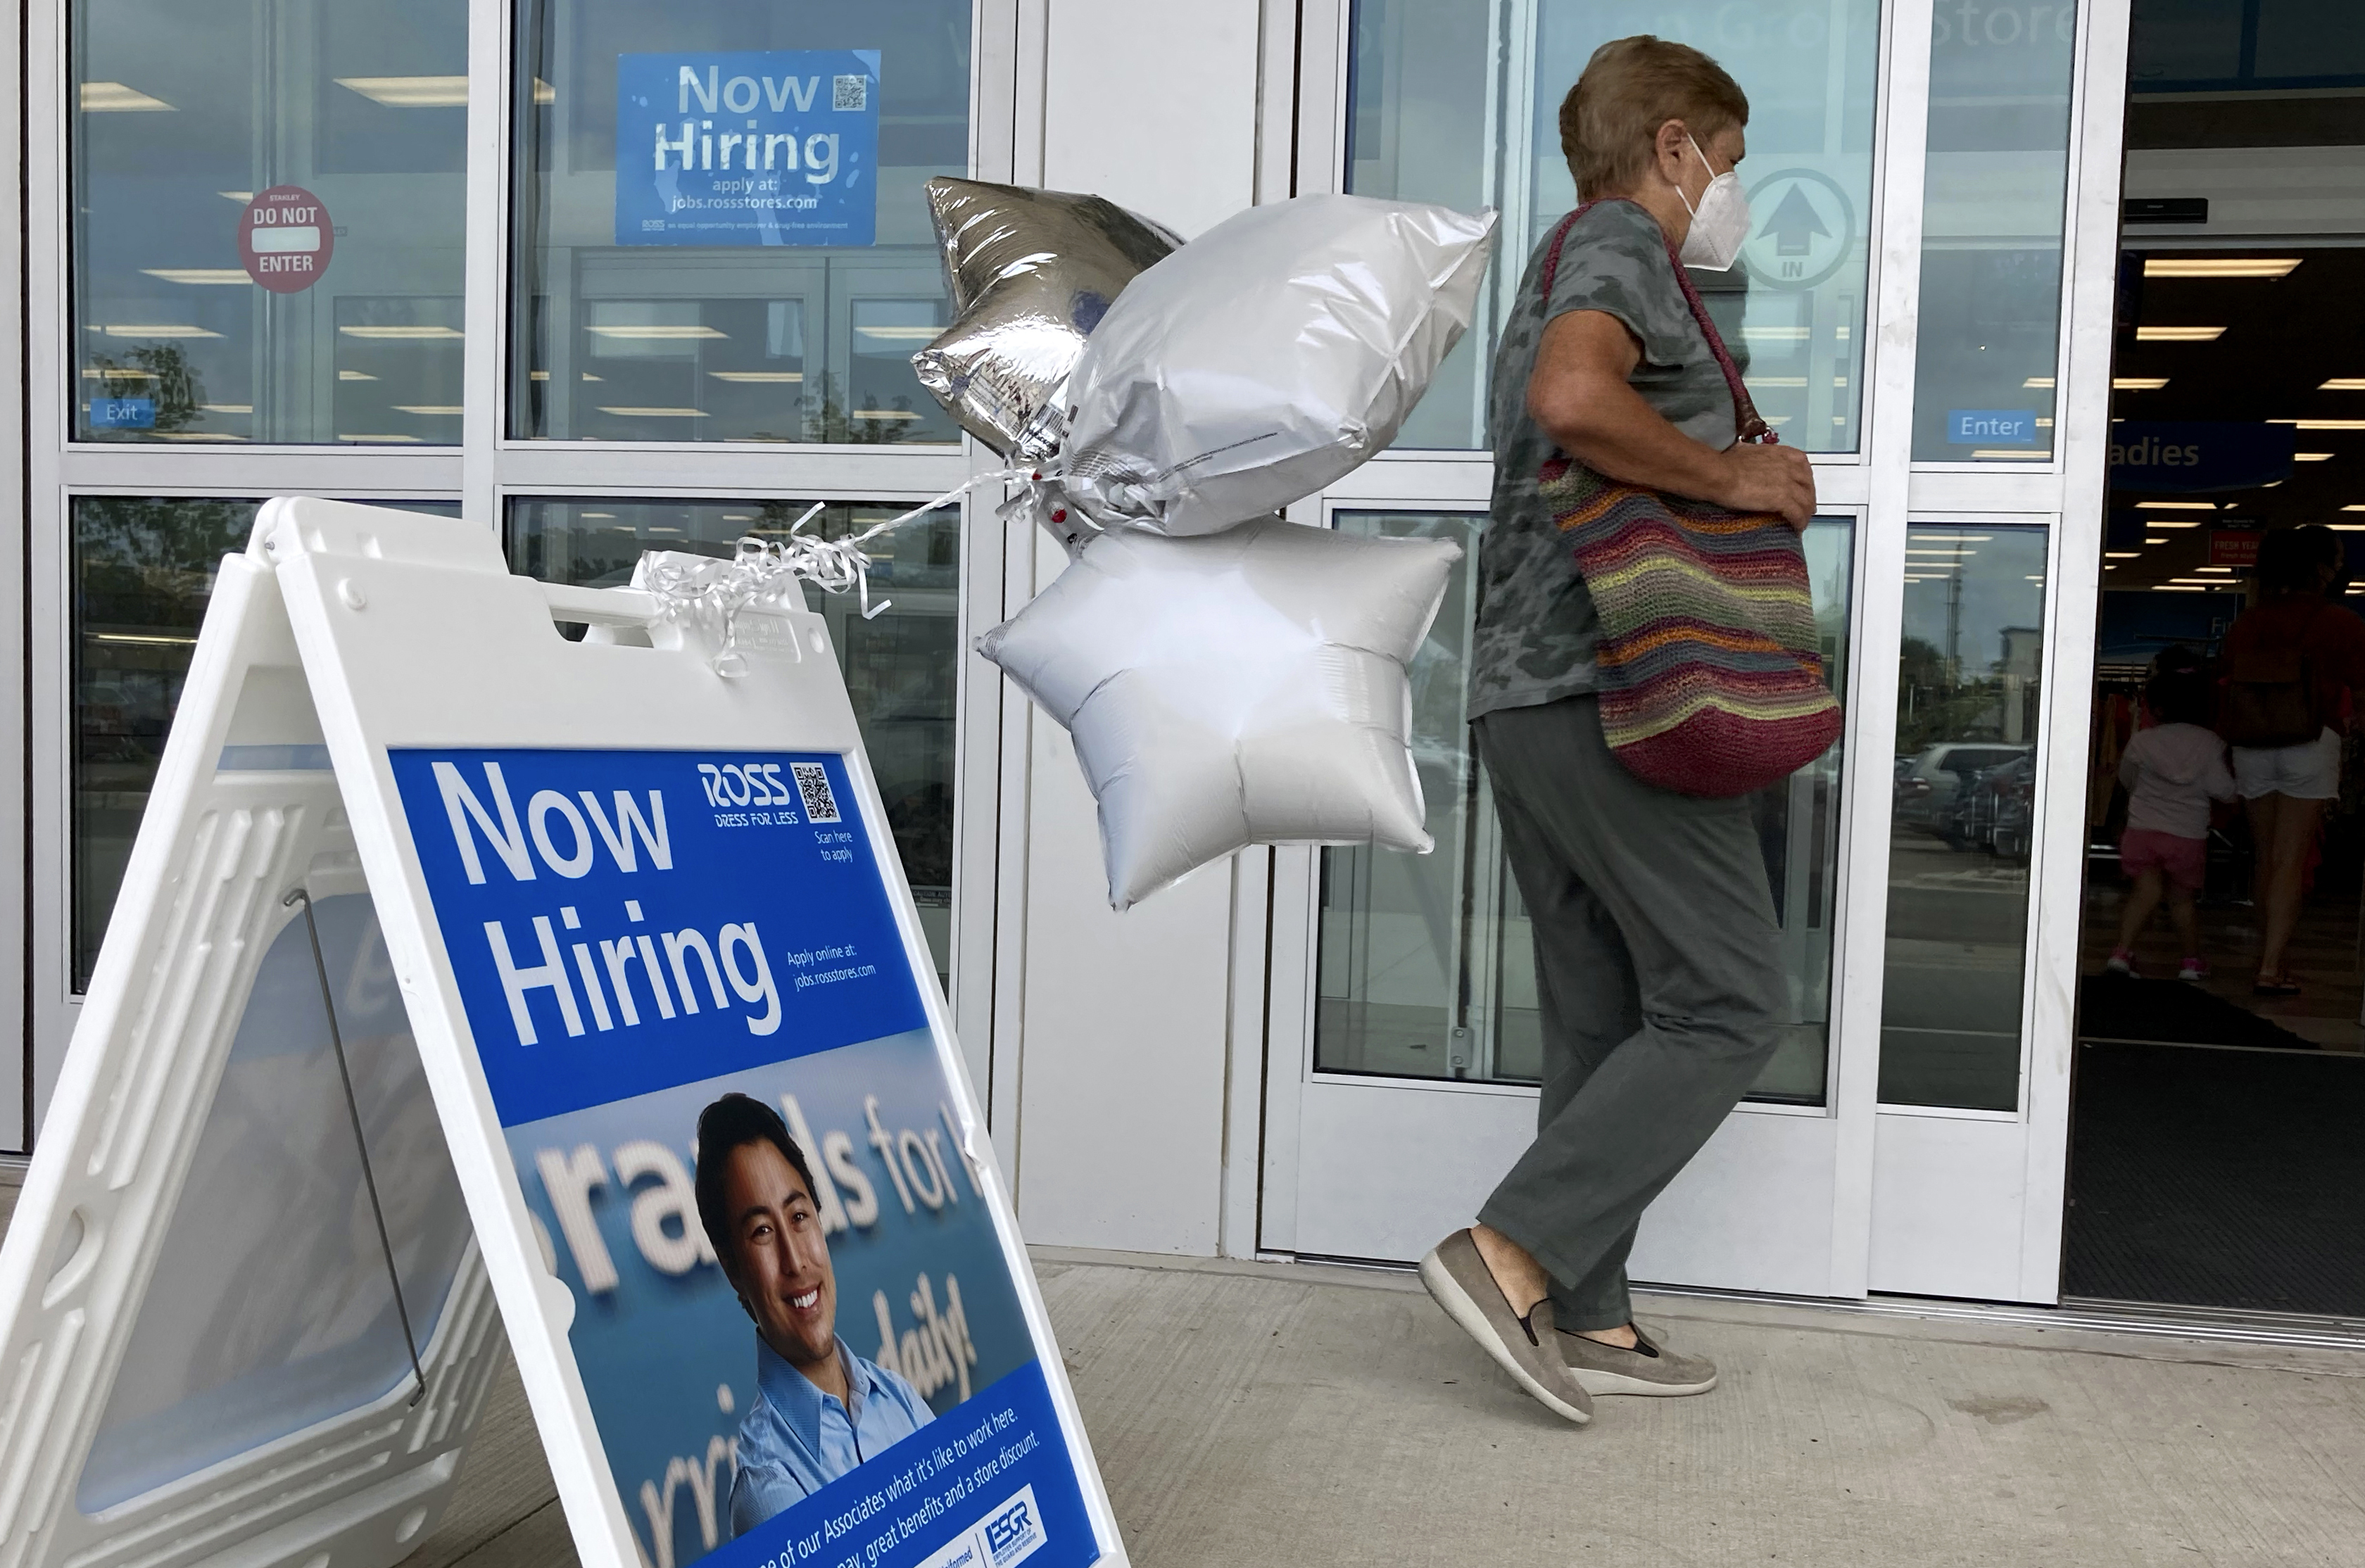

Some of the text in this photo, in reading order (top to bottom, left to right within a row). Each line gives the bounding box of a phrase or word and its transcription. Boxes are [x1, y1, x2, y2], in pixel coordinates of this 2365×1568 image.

[679, 65, 820, 113] Now
[655, 119, 840, 184] Hiring
[712, 177, 778, 194] apply at:
[253, 207, 317, 225] DO NOT
[671, 195, 817, 212] jobs.rossstores.com
[259, 255, 313, 272] ENTER
[1781, 261, 1803, 277] IN
[106, 403, 137, 420] Exit
[1961, 417, 2023, 436] Enter
[2110, 436, 2200, 466] adies
[698, 763, 790, 807] ROSS
[431, 761, 673, 885] Now
[714, 811, 798, 827] DRESS FOR LESS
[814, 829, 852, 844] Scan here
[821, 847, 852, 864] to apply
[788, 944, 857, 968] Apply online at:
[484, 900, 783, 1047] Hiring
[793, 964, 876, 992] jobs.rossstores.com
[863, 1093, 959, 1215] for
[873, 1271, 978, 1405] daily!
[780, 1407, 1018, 1568] of our Associates what it's like to work here.
[837, 1430, 1040, 1568] ay, great benefits and a store discount.
[985, 1500, 1033, 1554] ESGR
[993, 1527, 1031, 1562] EMPLOYER SUPPORT OF
[1002, 1550, 1015, 1563] GUARD
[1021, 1532, 1037, 1547] RESERVE
